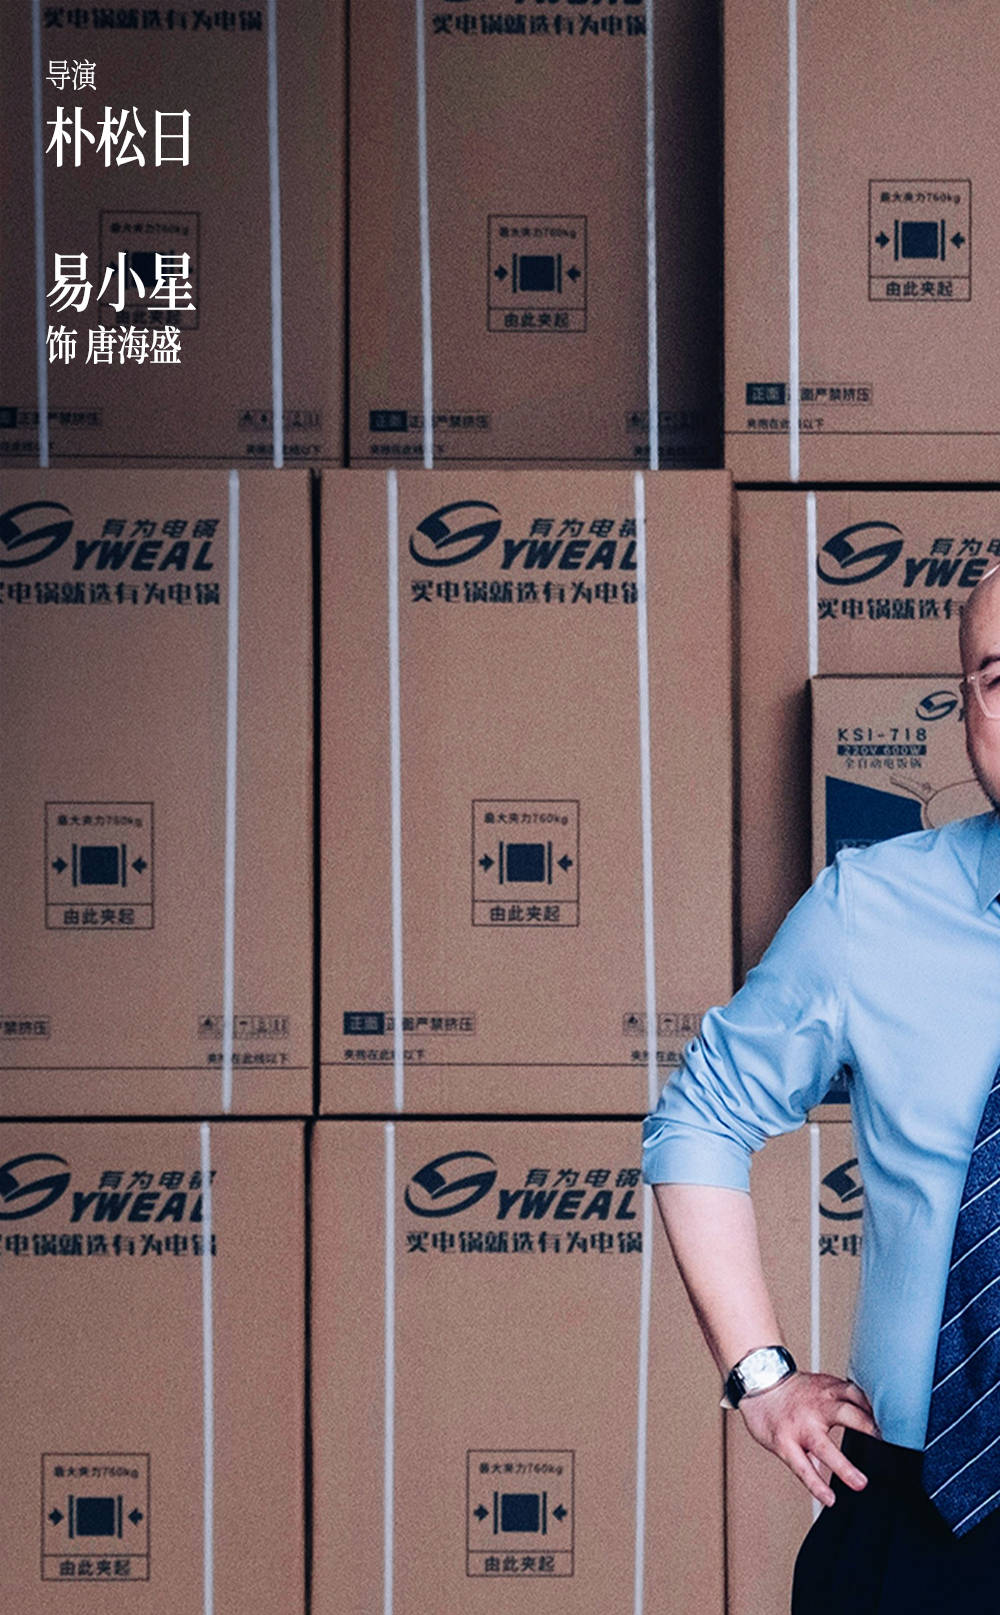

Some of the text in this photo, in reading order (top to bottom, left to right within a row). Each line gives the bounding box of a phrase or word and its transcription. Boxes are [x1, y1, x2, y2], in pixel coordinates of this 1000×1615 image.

[885, 281, 953, 297] 由此夹起
[902, 558, 989, 588] YWE
[0, 581, 221, 605] 电锅就选有为电锅
[817, 598, 963, 620] 买电锅就选有
[838, 727, 928, 742] KSI-718
[64, 908, 134, 925] 由此夹起
[489, 905, 560, 922] 由此夹起
[496, 1189, 638, 1221] YWEAL
[0, 1233, 217, 1257] 电锅就选有为电锅
[406, 1231, 644, 1254] 买电锅就选有为电锅
[59, 1560, 130, 1576] 由此夹起
[485, 1555, 555, 1572] 由此夹起
